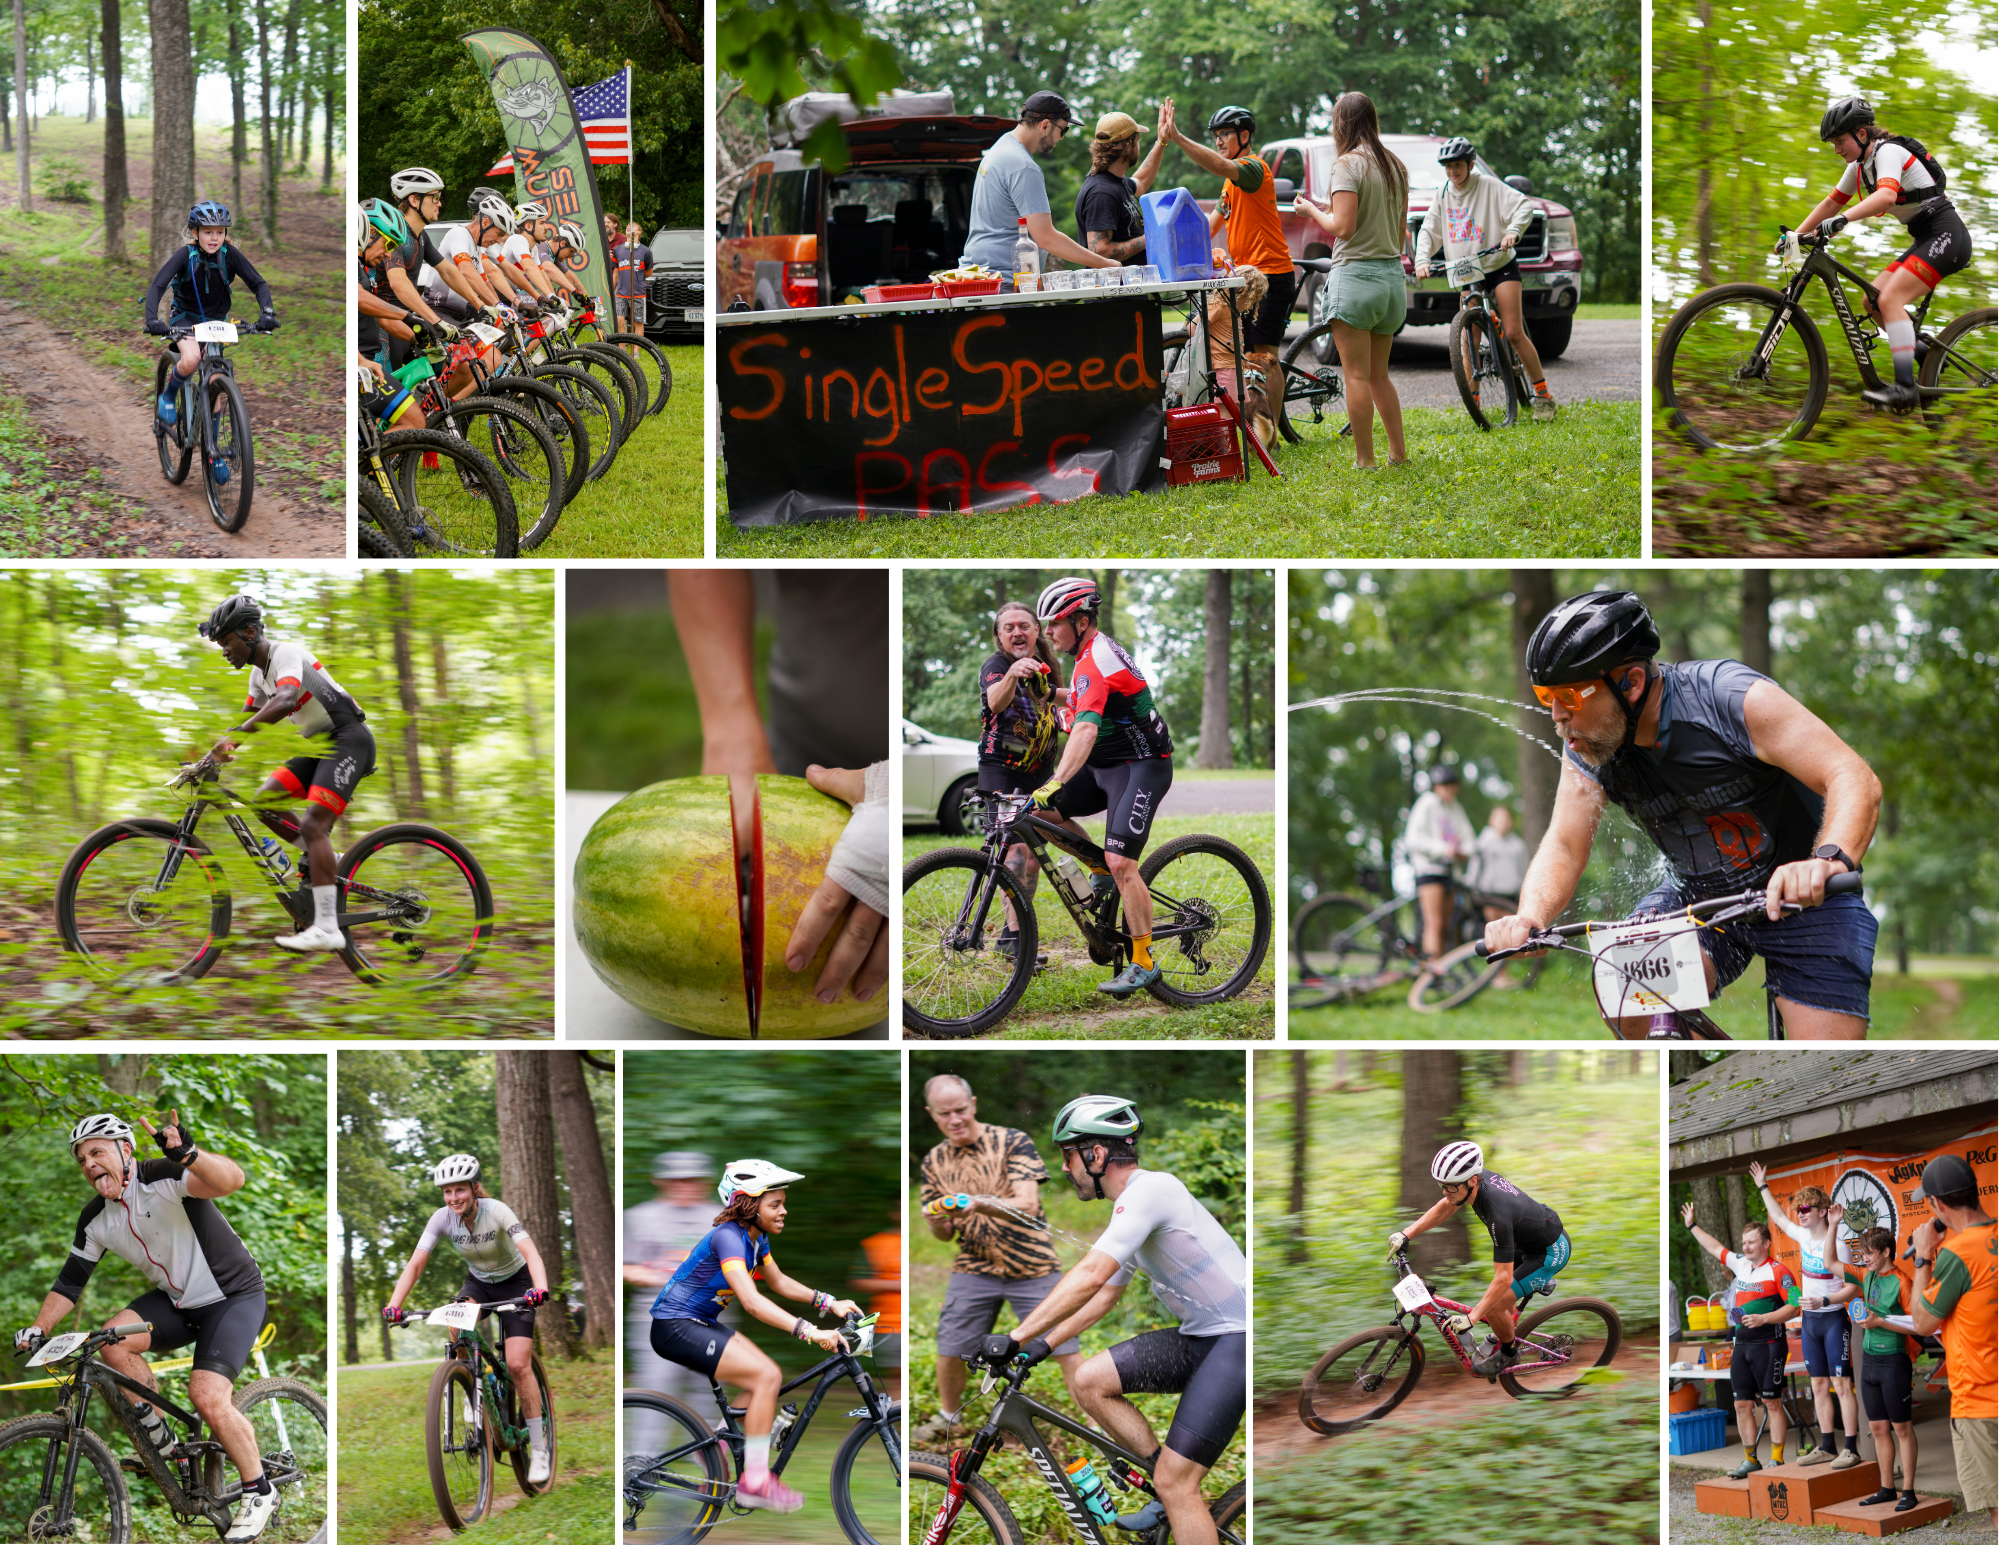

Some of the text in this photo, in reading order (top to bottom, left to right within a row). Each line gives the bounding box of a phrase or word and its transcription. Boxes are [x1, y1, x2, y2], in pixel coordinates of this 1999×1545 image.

[549, 165, 592, 272] SEO
[1109, 286, 1142, 296] SEMO
[1830, 286, 1869, 365] SPECIALIZED
[1760, 318, 1786, 363] SID
[494, 404, 536, 430] GROUND CONTROL
[854, 433, 1100, 522] PASS
[1191, 460, 1220, 472] Prairie
[1193, 467, 1220, 478] Farms
[1128, 788, 1148, 835] CITY
[1106, 838, 1126, 850] BPR
[376, 909, 405, 918] SCOTT
[1966, 1146, 1997, 1165] P&G
[1893, 1160, 1928, 1181] AgXpl
[1902, 1210, 1931, 1218] SYSTEMS
[1841, 1328, 1852, 1361] FreeFly
[1030, 1447, 1100, 1545] SPECIALIZ
